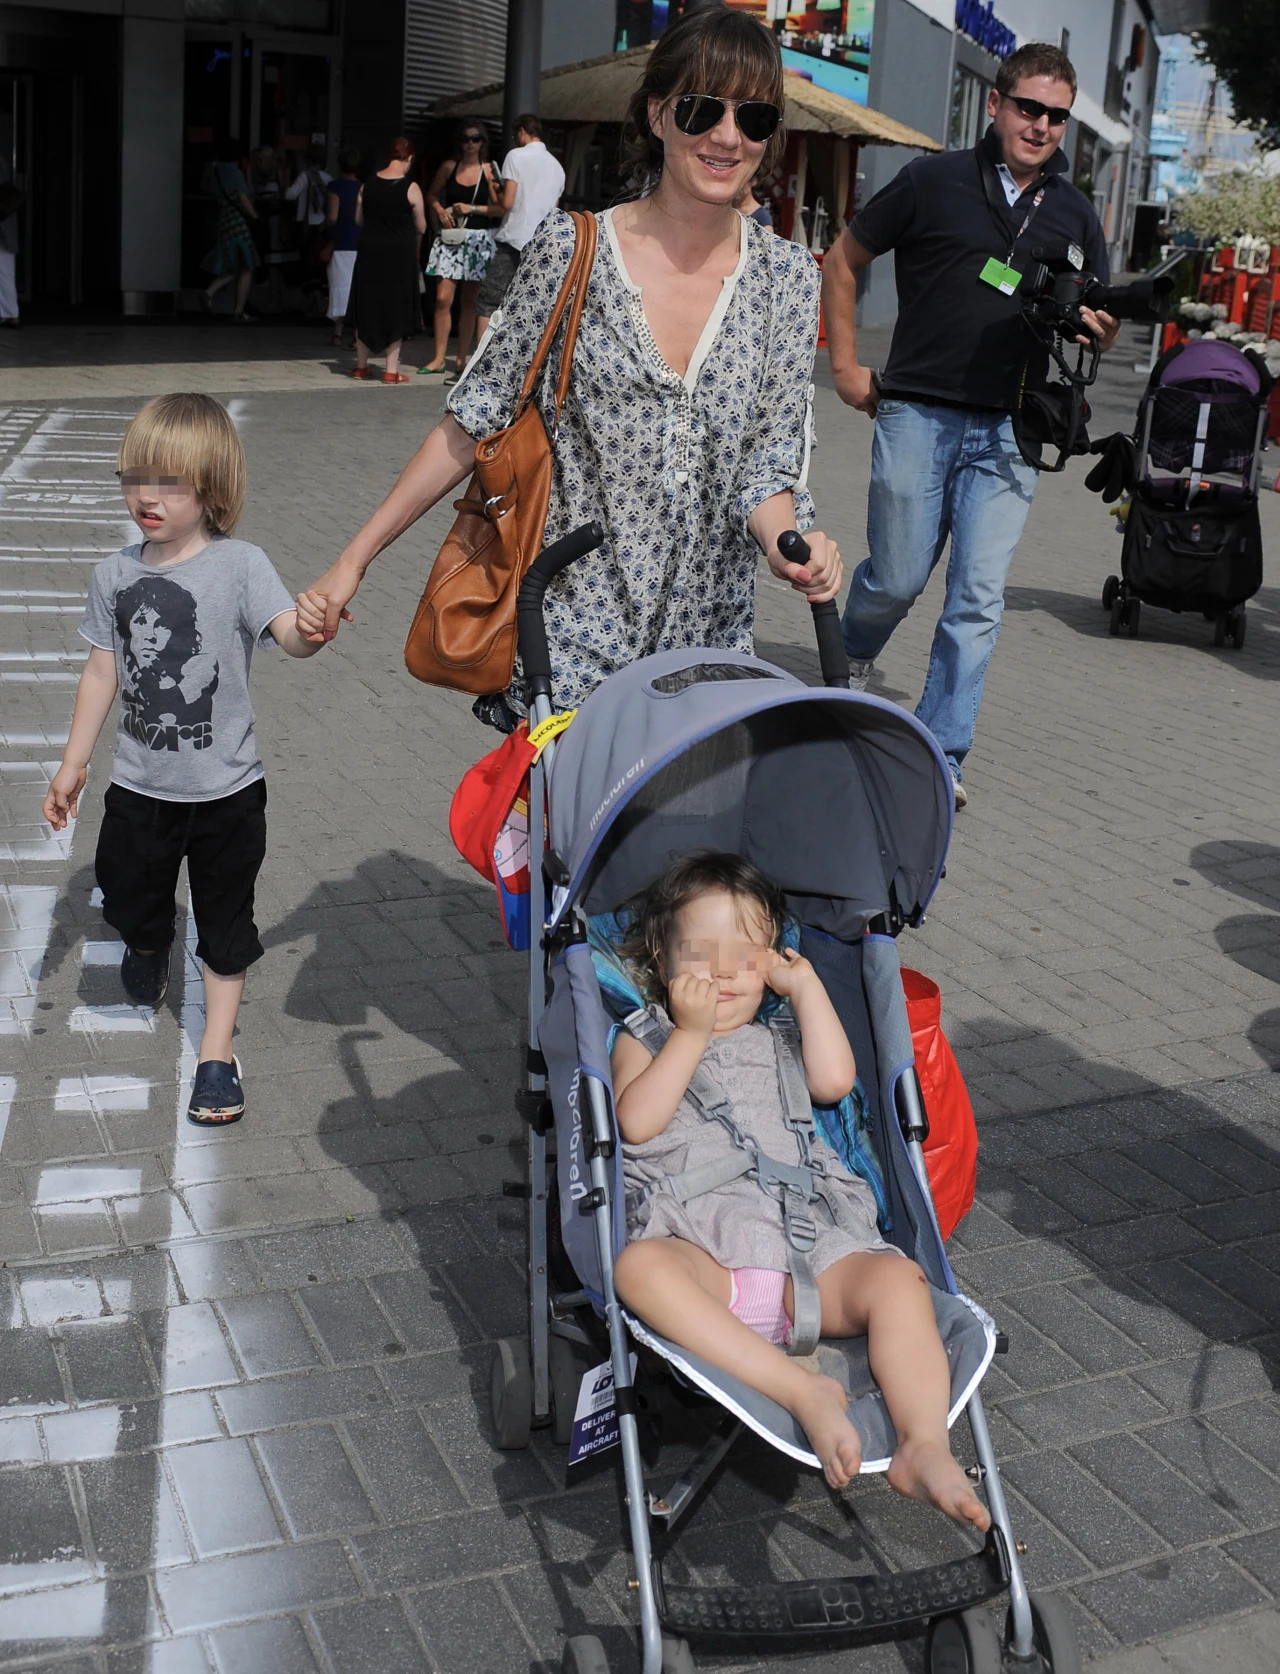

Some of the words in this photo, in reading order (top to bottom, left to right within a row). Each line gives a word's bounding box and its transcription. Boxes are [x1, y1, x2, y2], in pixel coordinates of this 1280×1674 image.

[567, 1067, 588, 1200] maclaren
[591, 1374, 615, 1395] LO
[581, 1409, 616, 1432] DELIVER
[595, 1425, 606, 1436] AT
[578, 1430, 619, 1455] AIRCRAFT
